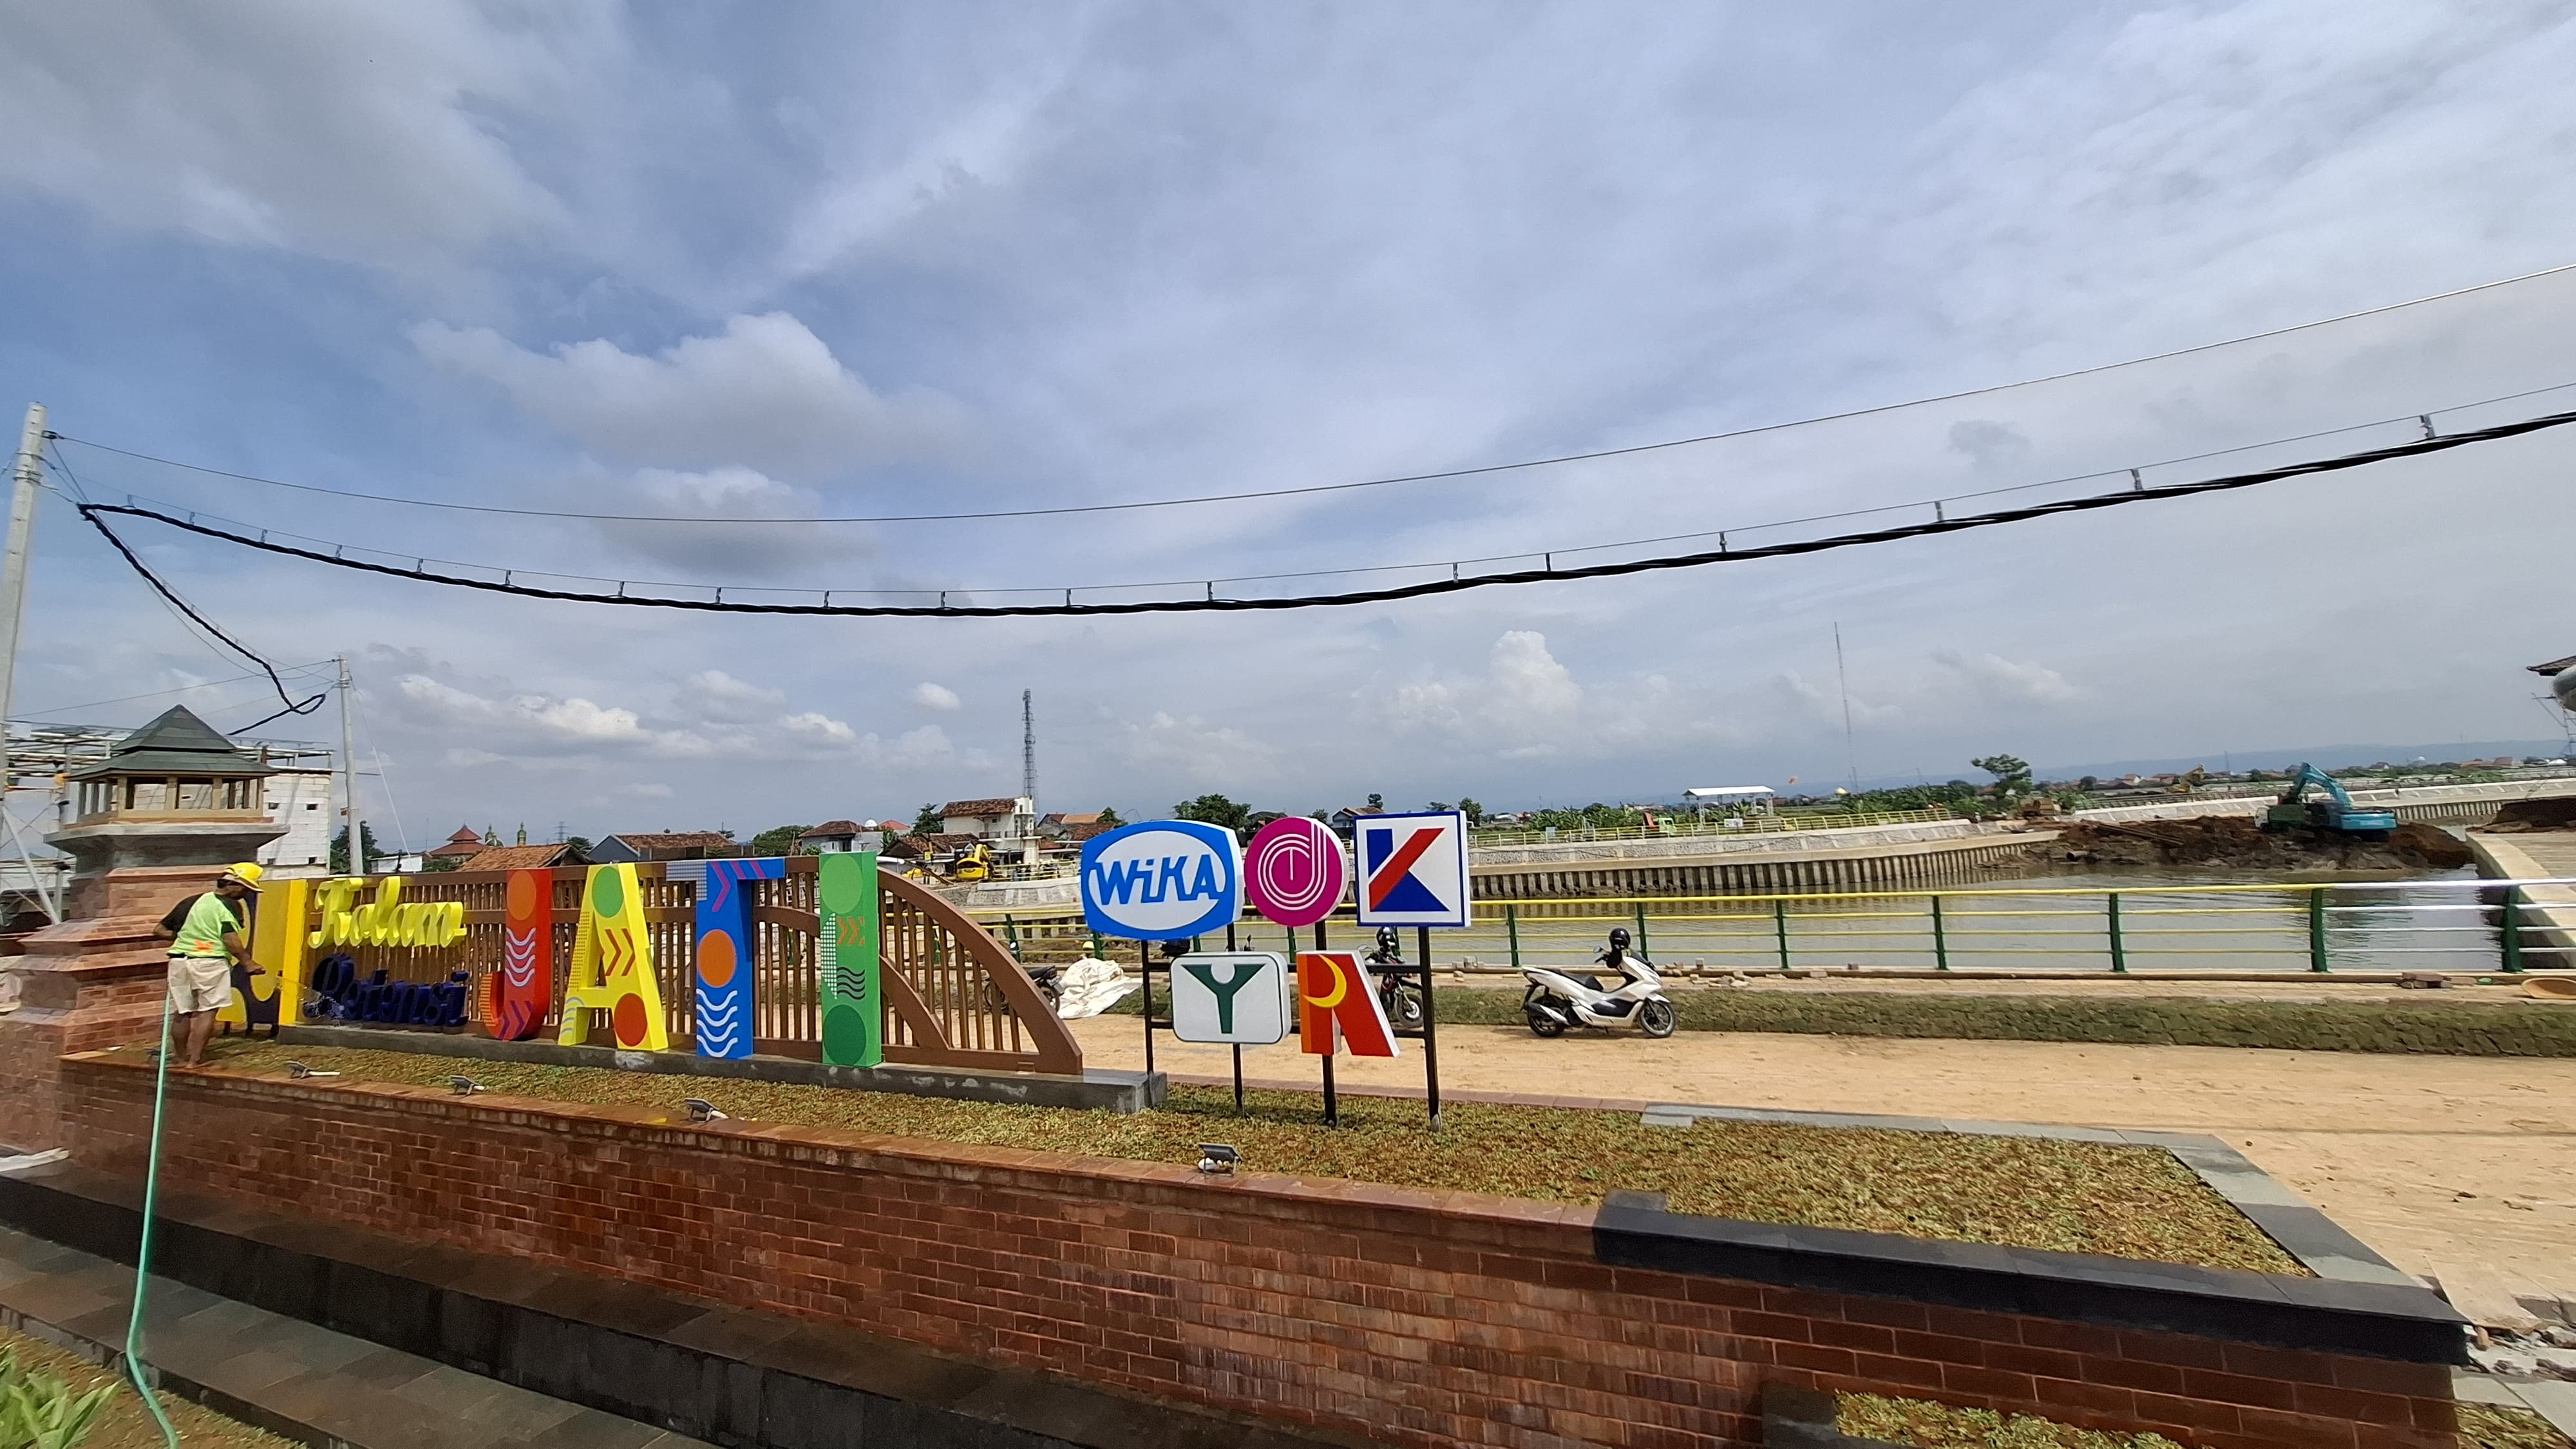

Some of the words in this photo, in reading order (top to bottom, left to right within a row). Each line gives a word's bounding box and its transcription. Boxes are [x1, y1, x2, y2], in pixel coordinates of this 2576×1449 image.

[1366, 828, 1450, 912] K
[308, 876, 467, 949] Kolam
[480, 851, 882, 1067] JATI
